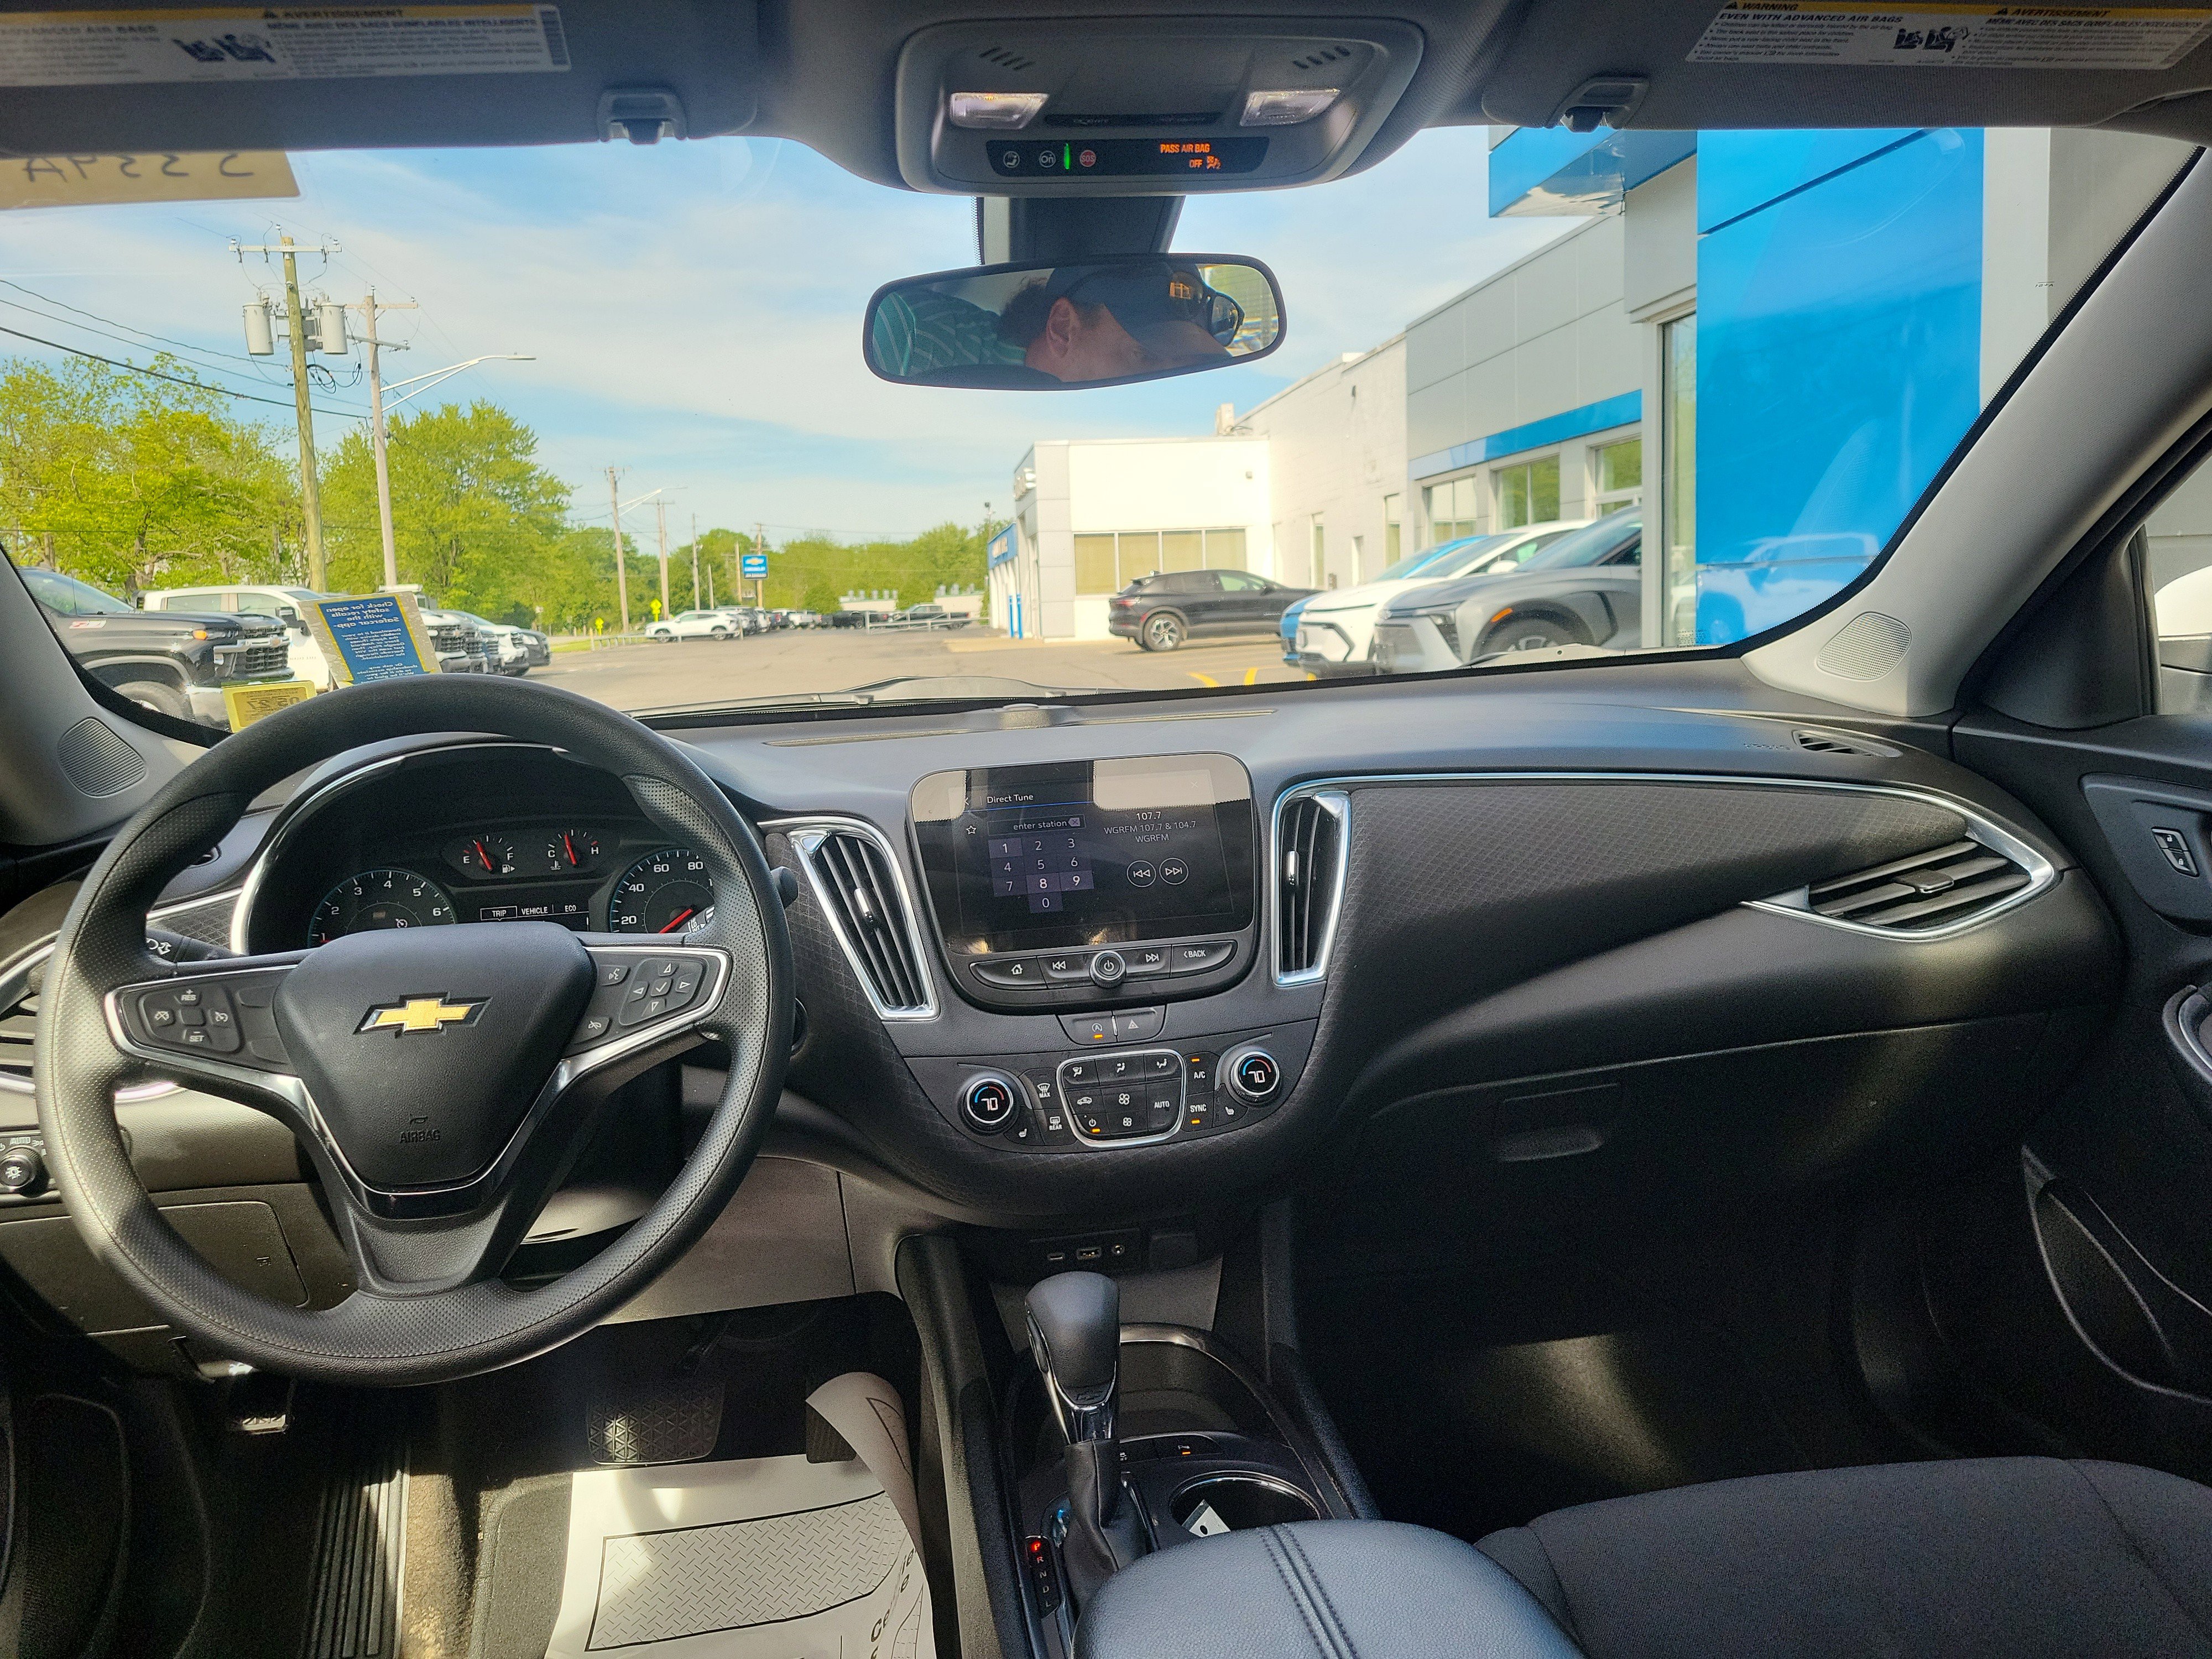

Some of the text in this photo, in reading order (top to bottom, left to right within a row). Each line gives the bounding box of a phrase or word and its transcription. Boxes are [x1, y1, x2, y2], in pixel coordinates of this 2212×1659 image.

[1742, 3, 1798, 11] WARNING
[1160, 143, 1211, 153] PASS AIR BAG
[1081, 154, 1095, 164] SOS
[1190, 159, 1203, 168] OFF
[987, 794, 1034, 804] Direct Tune
[1136, 811, 1161, 821] 107.7
[1037, 820, 1067, 828] station
[1104, 826, 1138, 834] WGRFM
[1140, 823, 1162, 832] 107.7
[1174, 821, 1196, 829] 104.7
[1135, 833, 1170, 843] WGRFM
[1002, 838, 1075, 853] 1 2 3
[463, 855, 470, 864] E
[654, 864, 670, 873] 60
[687, 862, 703, 870] 80
[1004, 857, 1078, 872] 4 5 6
[383, 880, 392, 889] 4
[628, 883, 644, 892] 40
[1006, 875, 1080, 891] 7 8 9
[354, 887, 362, 895] 3
[413, 888, 421, 896] 5
[1042, 898, 1050, 908] 0
[331, 906, 340, 915] 2
[432, 907, 441, 916] 6
[521, 907, 548, 916] VEHICLE
[621, 915, 637, 925] 20
[321, 932, 325, 941] 1
[1188, 950, 1206, 959] BACK
[181, 993, 196, 1001] RES
[1193, 1071, 1206, 1080] A/C
[1248, 1071, 1264, 1084] 70
[981, 1098, 998, 1111] 70
[1154, 1100, 1170, 1109] AUTO
[1190, 1103, 1207, 1114] SYNC
[399, 1129, 441, 1144] AIRBAG
[1042, 1585, 1050, 1593] D
